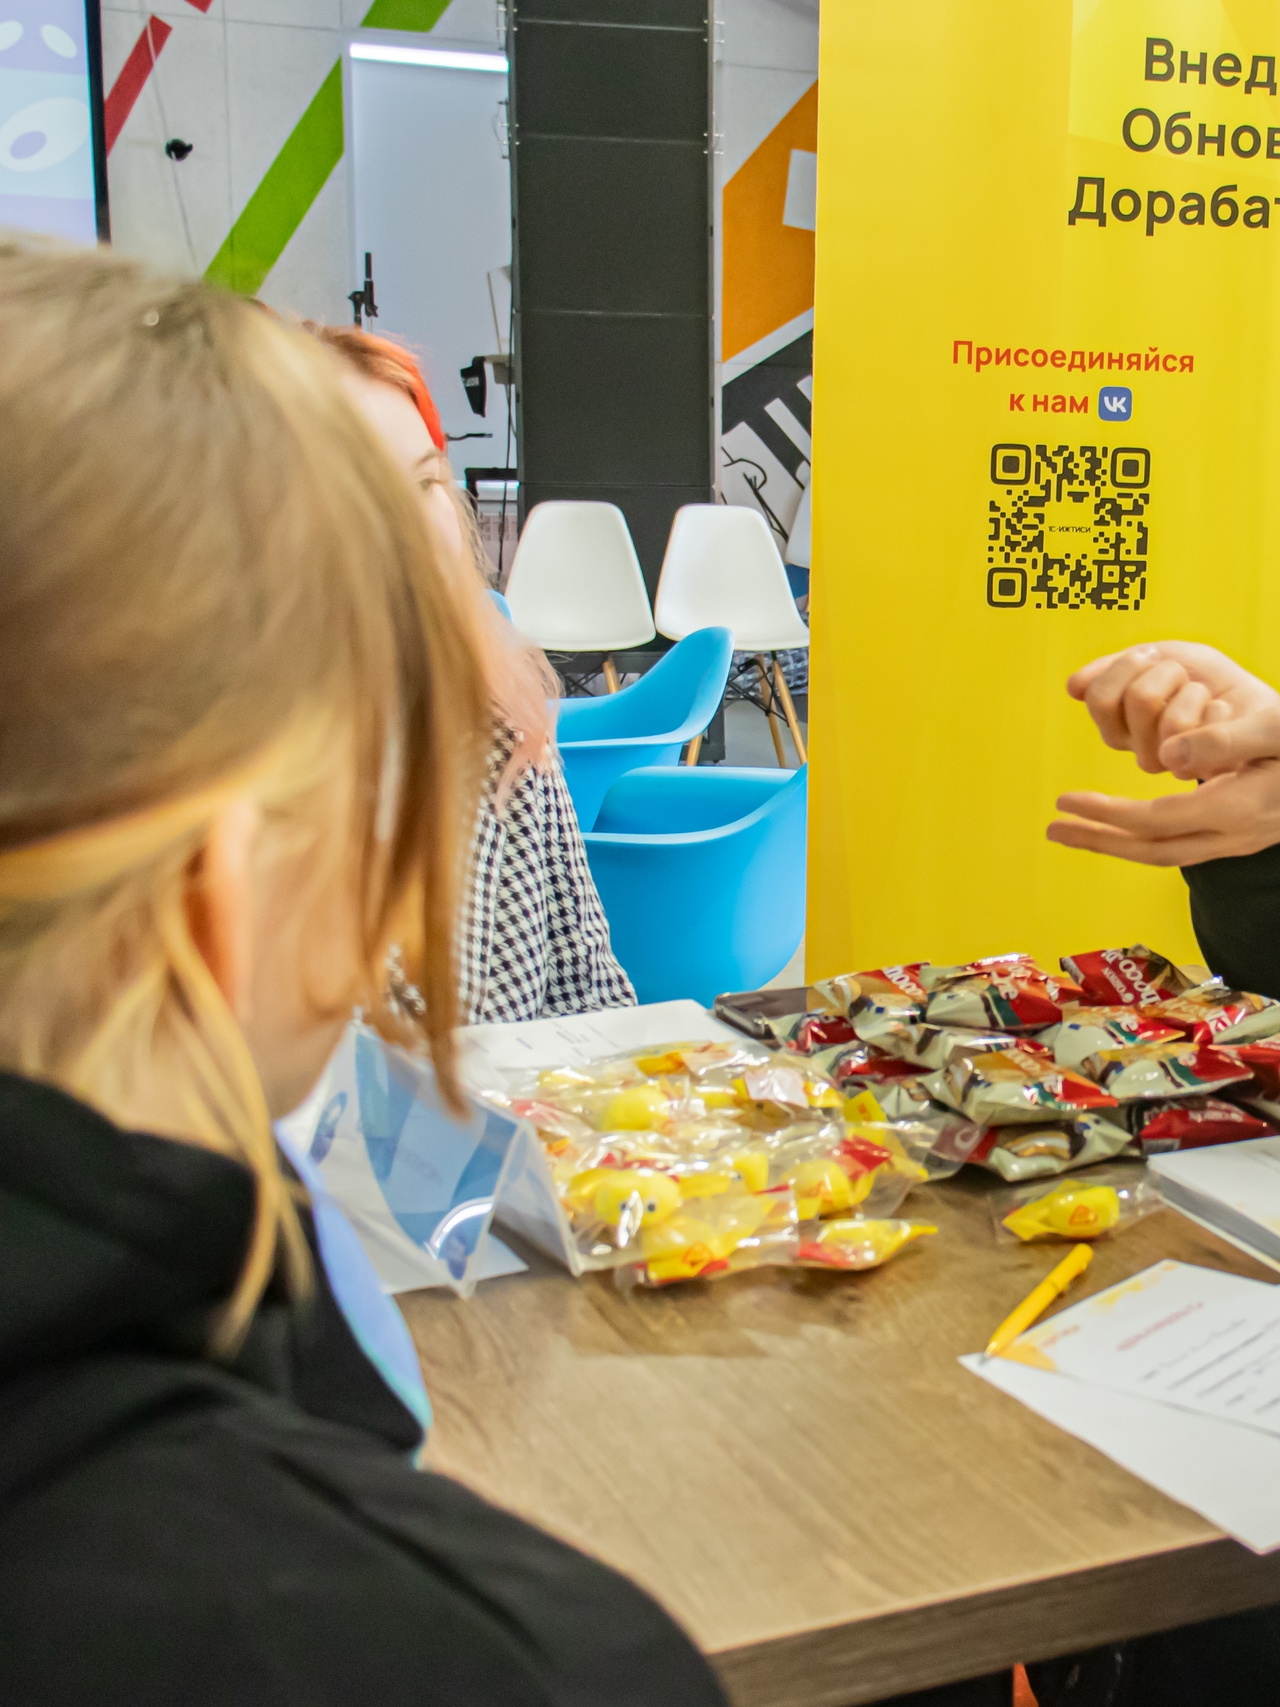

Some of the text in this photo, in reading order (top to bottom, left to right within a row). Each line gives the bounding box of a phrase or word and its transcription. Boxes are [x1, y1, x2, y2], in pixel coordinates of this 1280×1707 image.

[952, 340, 1194, 373] Присоединяйся
[1009, 393, 1089, 414] к нам
